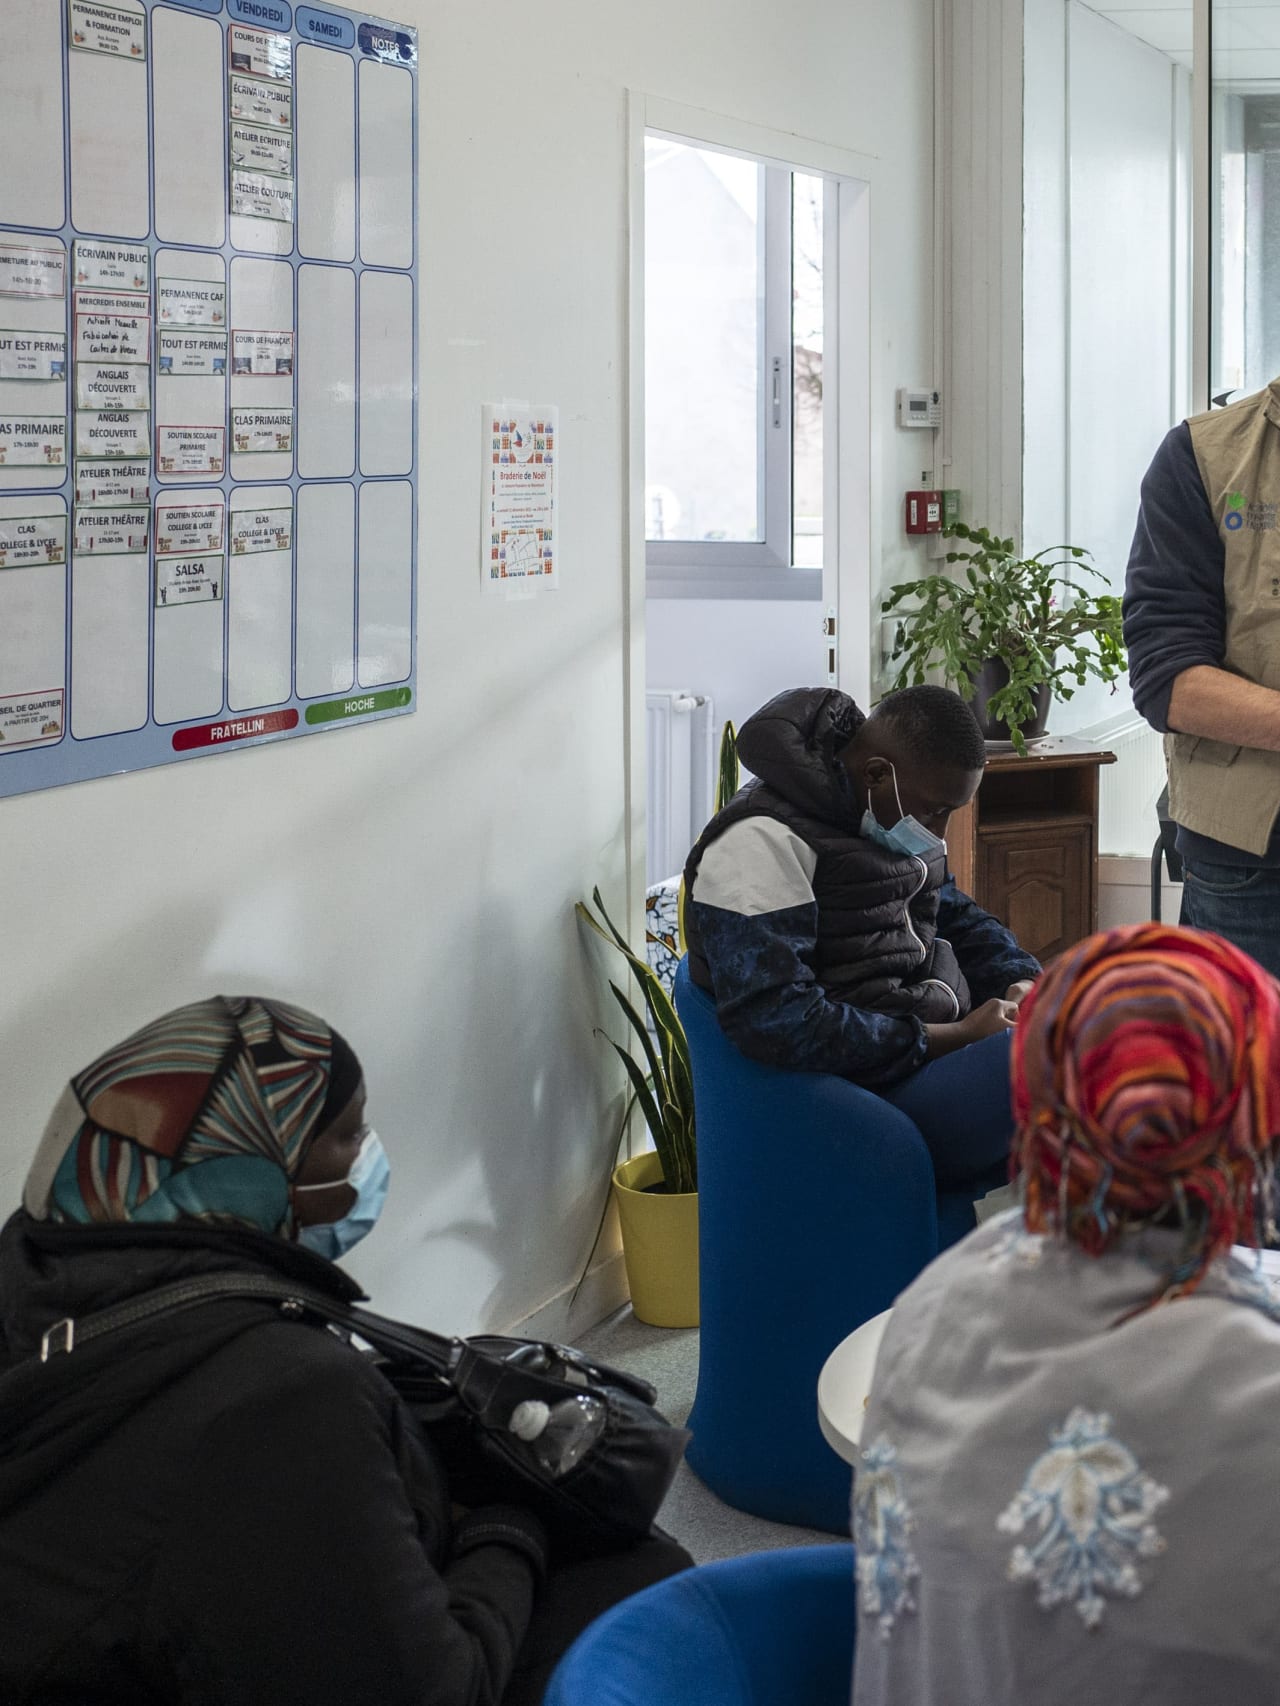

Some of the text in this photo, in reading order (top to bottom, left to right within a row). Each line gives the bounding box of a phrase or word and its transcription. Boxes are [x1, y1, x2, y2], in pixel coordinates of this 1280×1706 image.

[73, 4, 142, 26] PERMANENCE EMPLOI
[237, 0, 283, 23] VENDREDI
[92, 21, 130, 36] FORMATION
[309, 20, 342, 38] SAMEDI
[234, 32, 255, 42] COURS
[256, 36, 264, 45] DE
[371, 35, 400, 52] NOTES
[233, 82, 290, 103] ÉCRIVAIN PUBLIC
[233, 131, 290, 148] ATELIER ECRITURE
[234, 183, 292, 200] ATELIER COUTURE
[77, 245, 148, 264] ÉCRIVAIN PUBLIC
[40, 260, 62, 269] PUBLIC
[160, 288, 224, 301] PERMANENCE CAF
[78, 297, 146, 309] MERCREDIS ENSEMBLE
[162, 339, 227, 351] TOUT EST PERMIS
[235, 335, 255, 344] COURS
[15, 340, 32, 351] EST
[34, 341, 66, 352] PERMIS
[96, 369, 129, 379] ANGLAIS
[88, 381, 137, 393] DÉCOUVERTE
[97, 413, 129, 423] ANGLAIS
[234, 416, 291, 425] CLAS PRIMAIRE
[15, 424, 64, 435] PRIMAIRE
[89, 426, 137, 438] DÉCOUVERTE
[167, 432, 217, 440] SOUTIEN SCOLAIRE
[179, 443, 206, 451] PRIMAIRE
[80, 465, 147, 479] ATELIER THÉÂTRE
[500, 471, 547, 480] Braderie de Noël
[78, 513, 145, 526] ATELIER THÉÂTRE
[166, 512, 190, 520] SOUTIEN
[255, 516, 269, 524] CLAS
[17, 525, 36, 534] CLAS
[168, 523, 193, 531] COLLEGE
[238, 529, 262, 538] COLLEGE
[29, 539, 35, 547] &
[175, 563, 205, 576] SALSA
[16, 704, 27, 712] DE
[28, 699, 62, 711] QUARTIER
[344, 697, 375, 715] HOCHE
[210, 718, 265, 741] FRATELLINI
